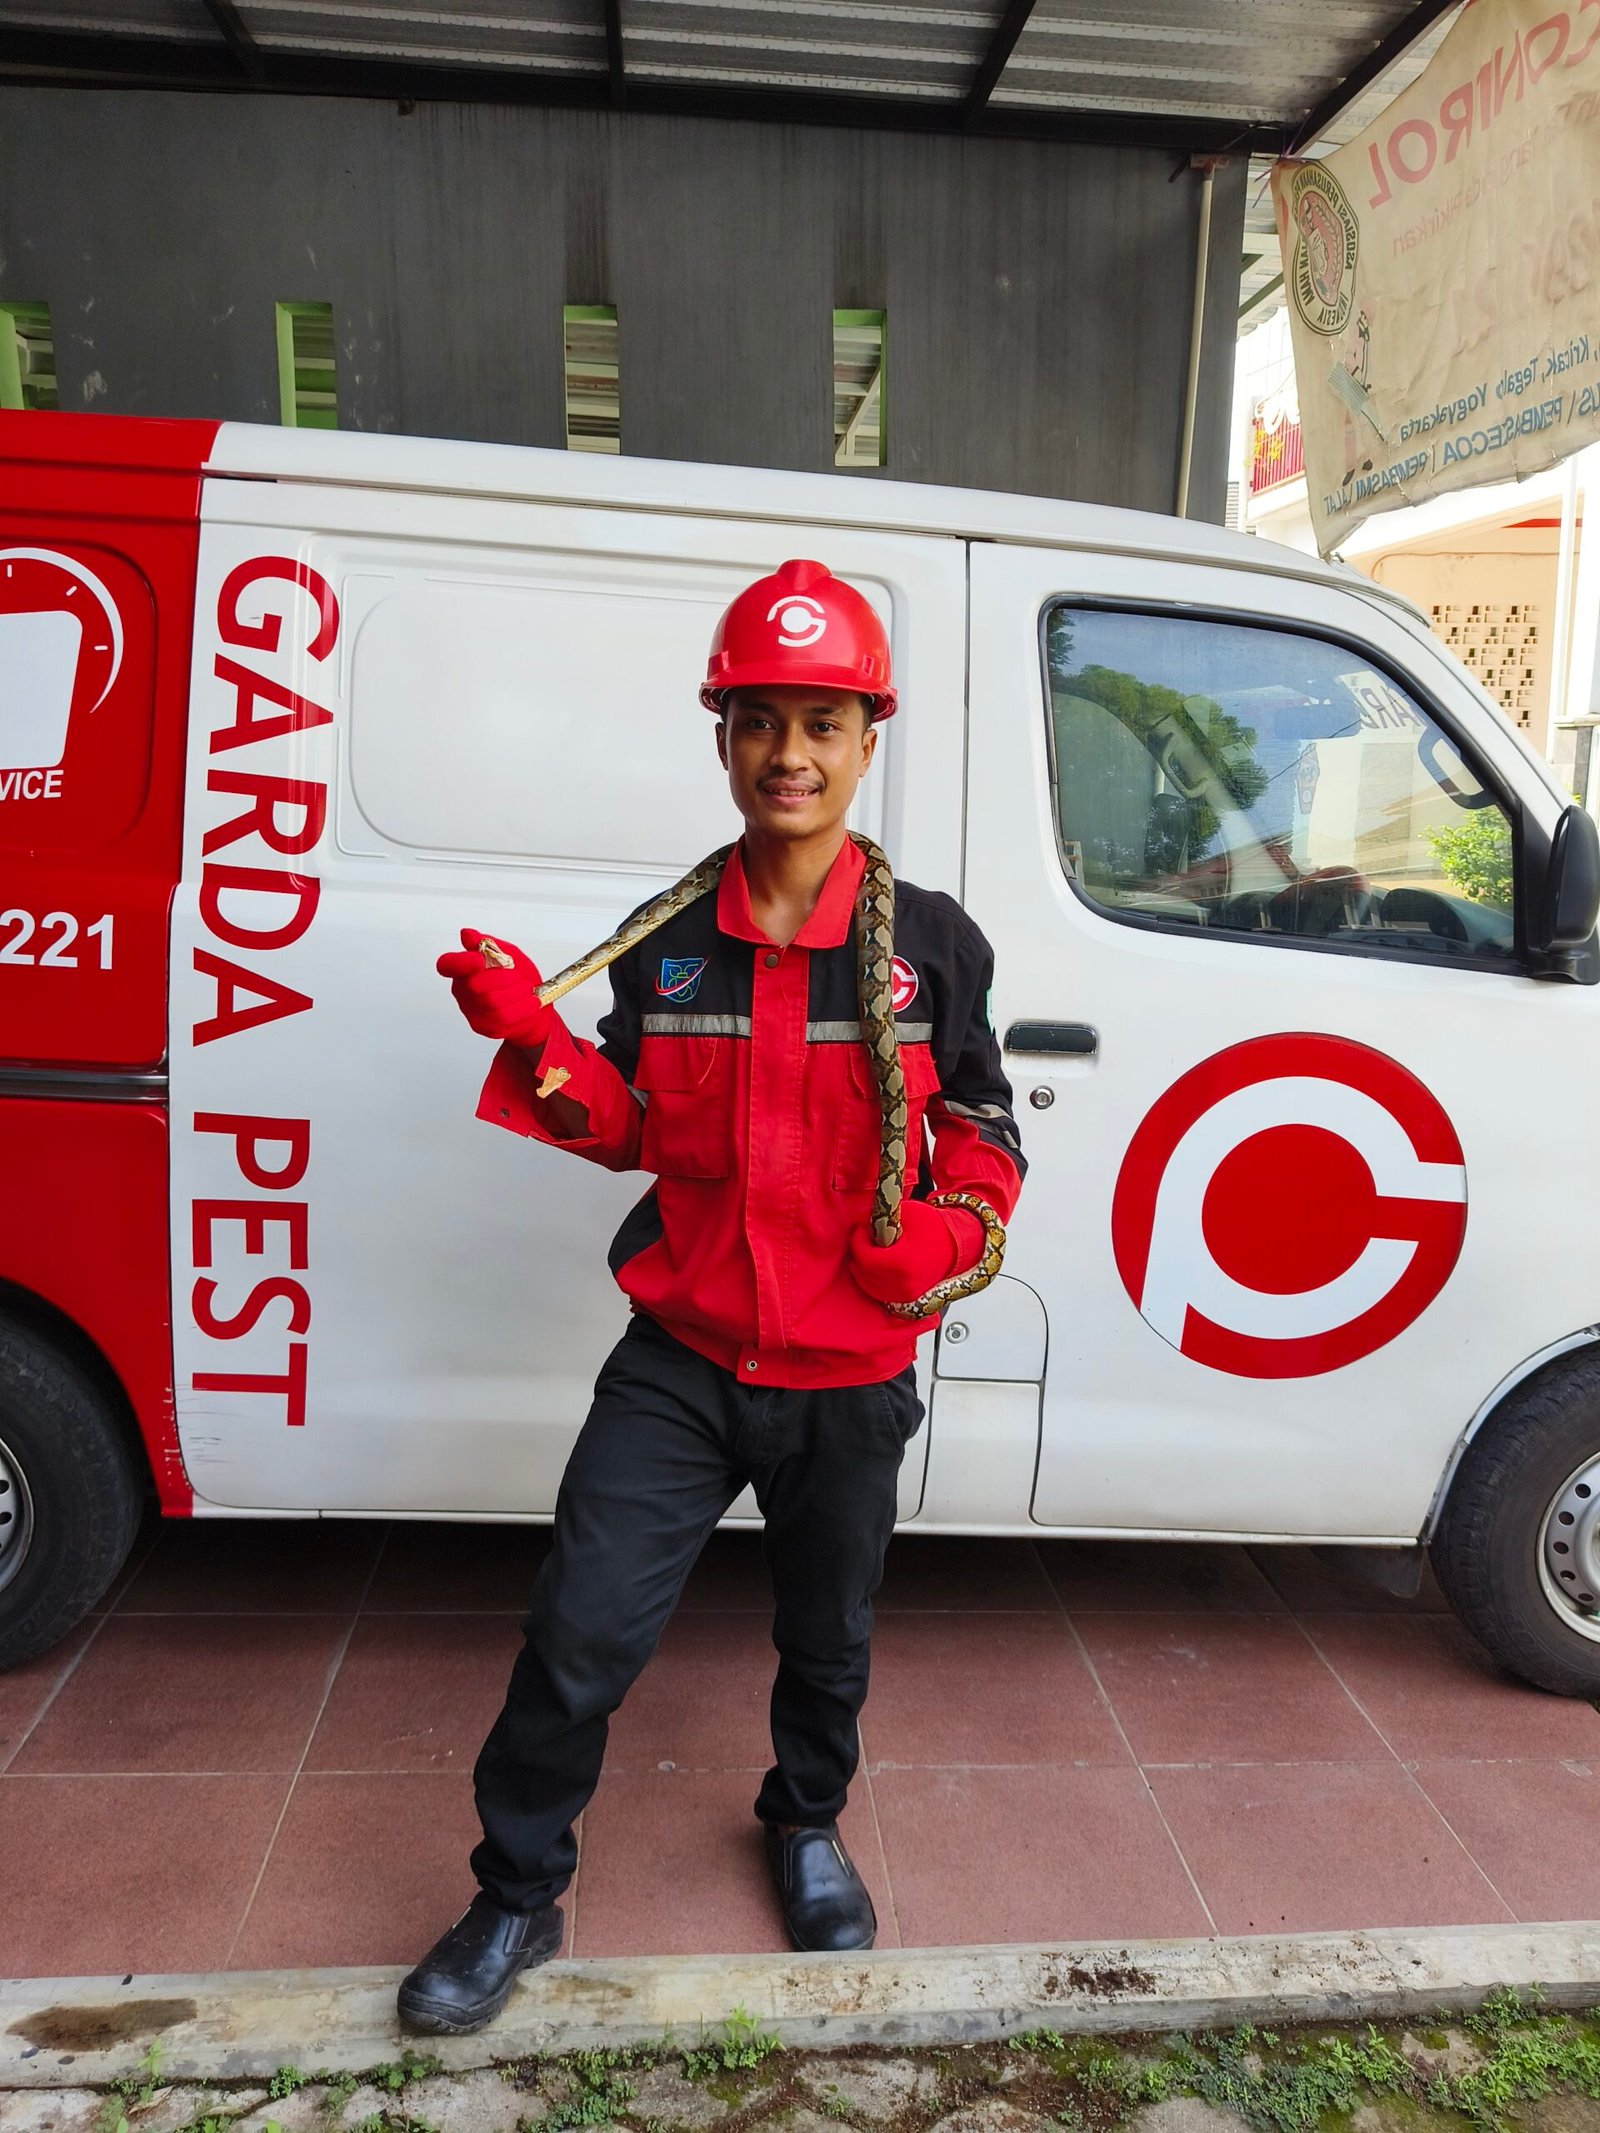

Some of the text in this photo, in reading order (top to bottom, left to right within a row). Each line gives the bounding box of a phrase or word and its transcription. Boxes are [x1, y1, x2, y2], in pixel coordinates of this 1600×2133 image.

[0, 908, 114, 970] 221
[191, 555, 341, 1427] GARDA PEST
